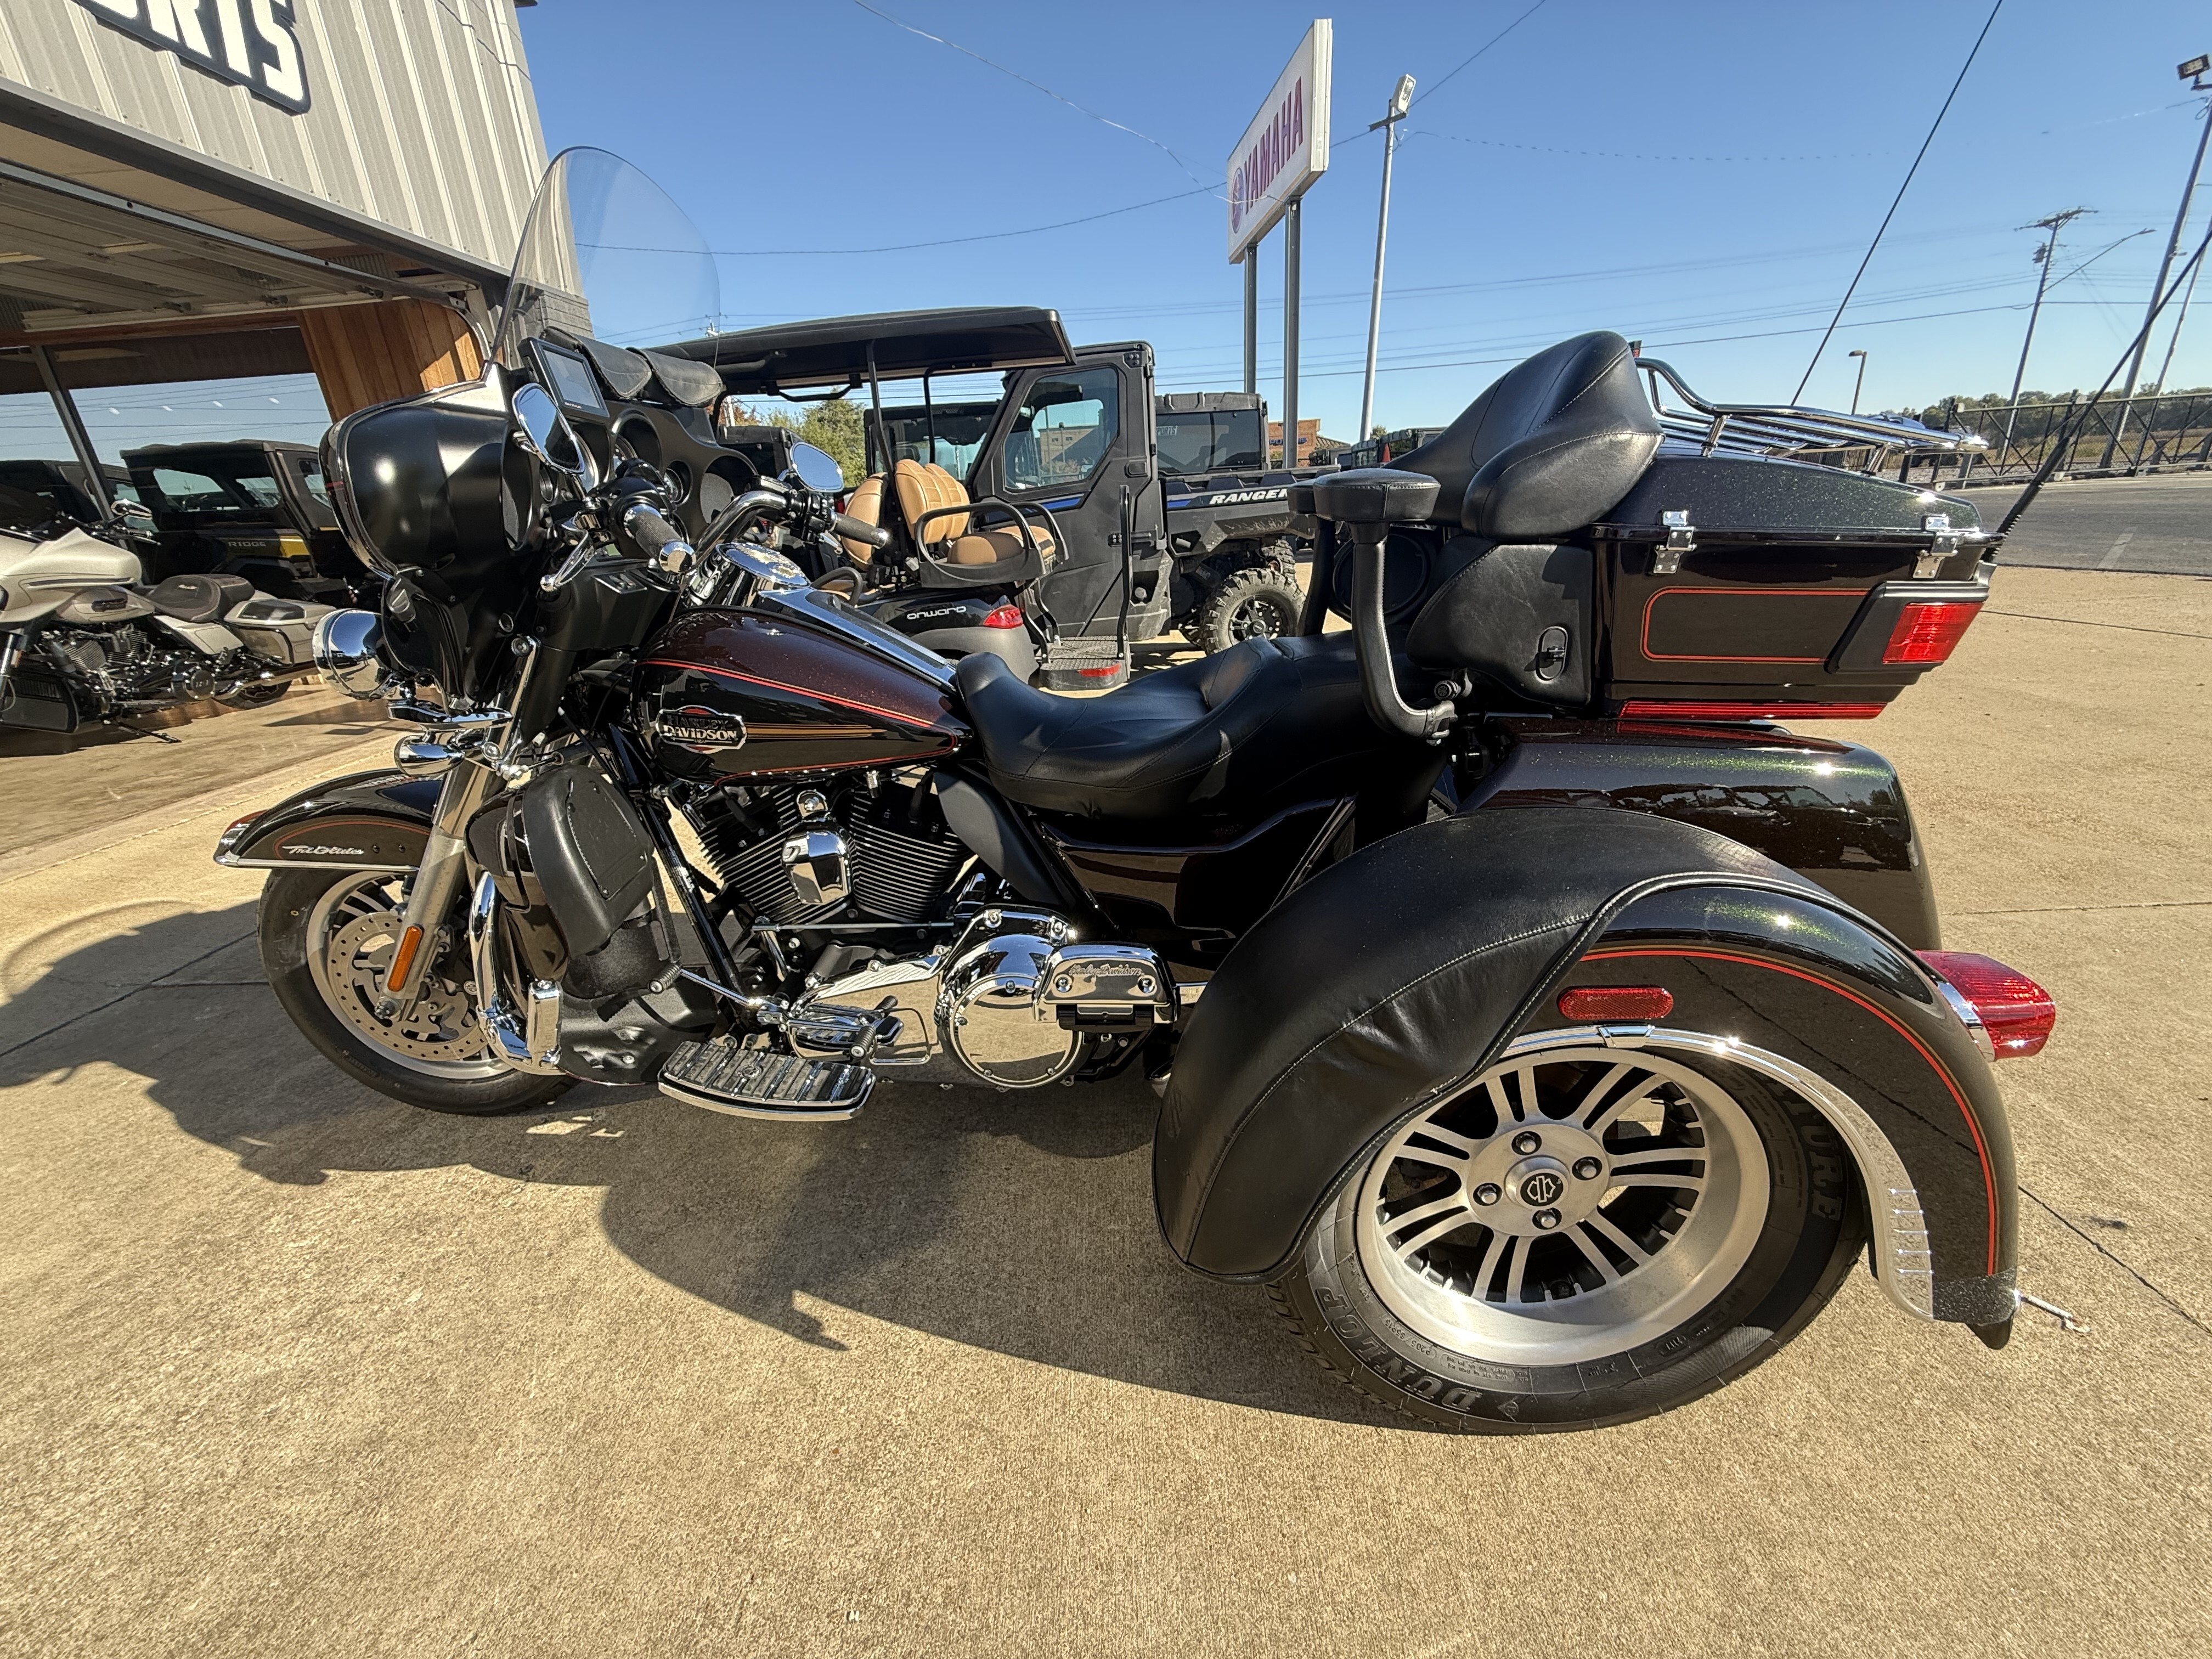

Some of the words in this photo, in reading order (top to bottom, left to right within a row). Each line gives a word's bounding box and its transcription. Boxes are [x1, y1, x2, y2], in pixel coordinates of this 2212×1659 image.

[92, 0, 304, 101] RTS
[1244, 76, 1303, 215] YAMAHA
[663, 725, 739, 741] DAVIDSON
[1316, 1286, 1483, 1412] DUNLOP
